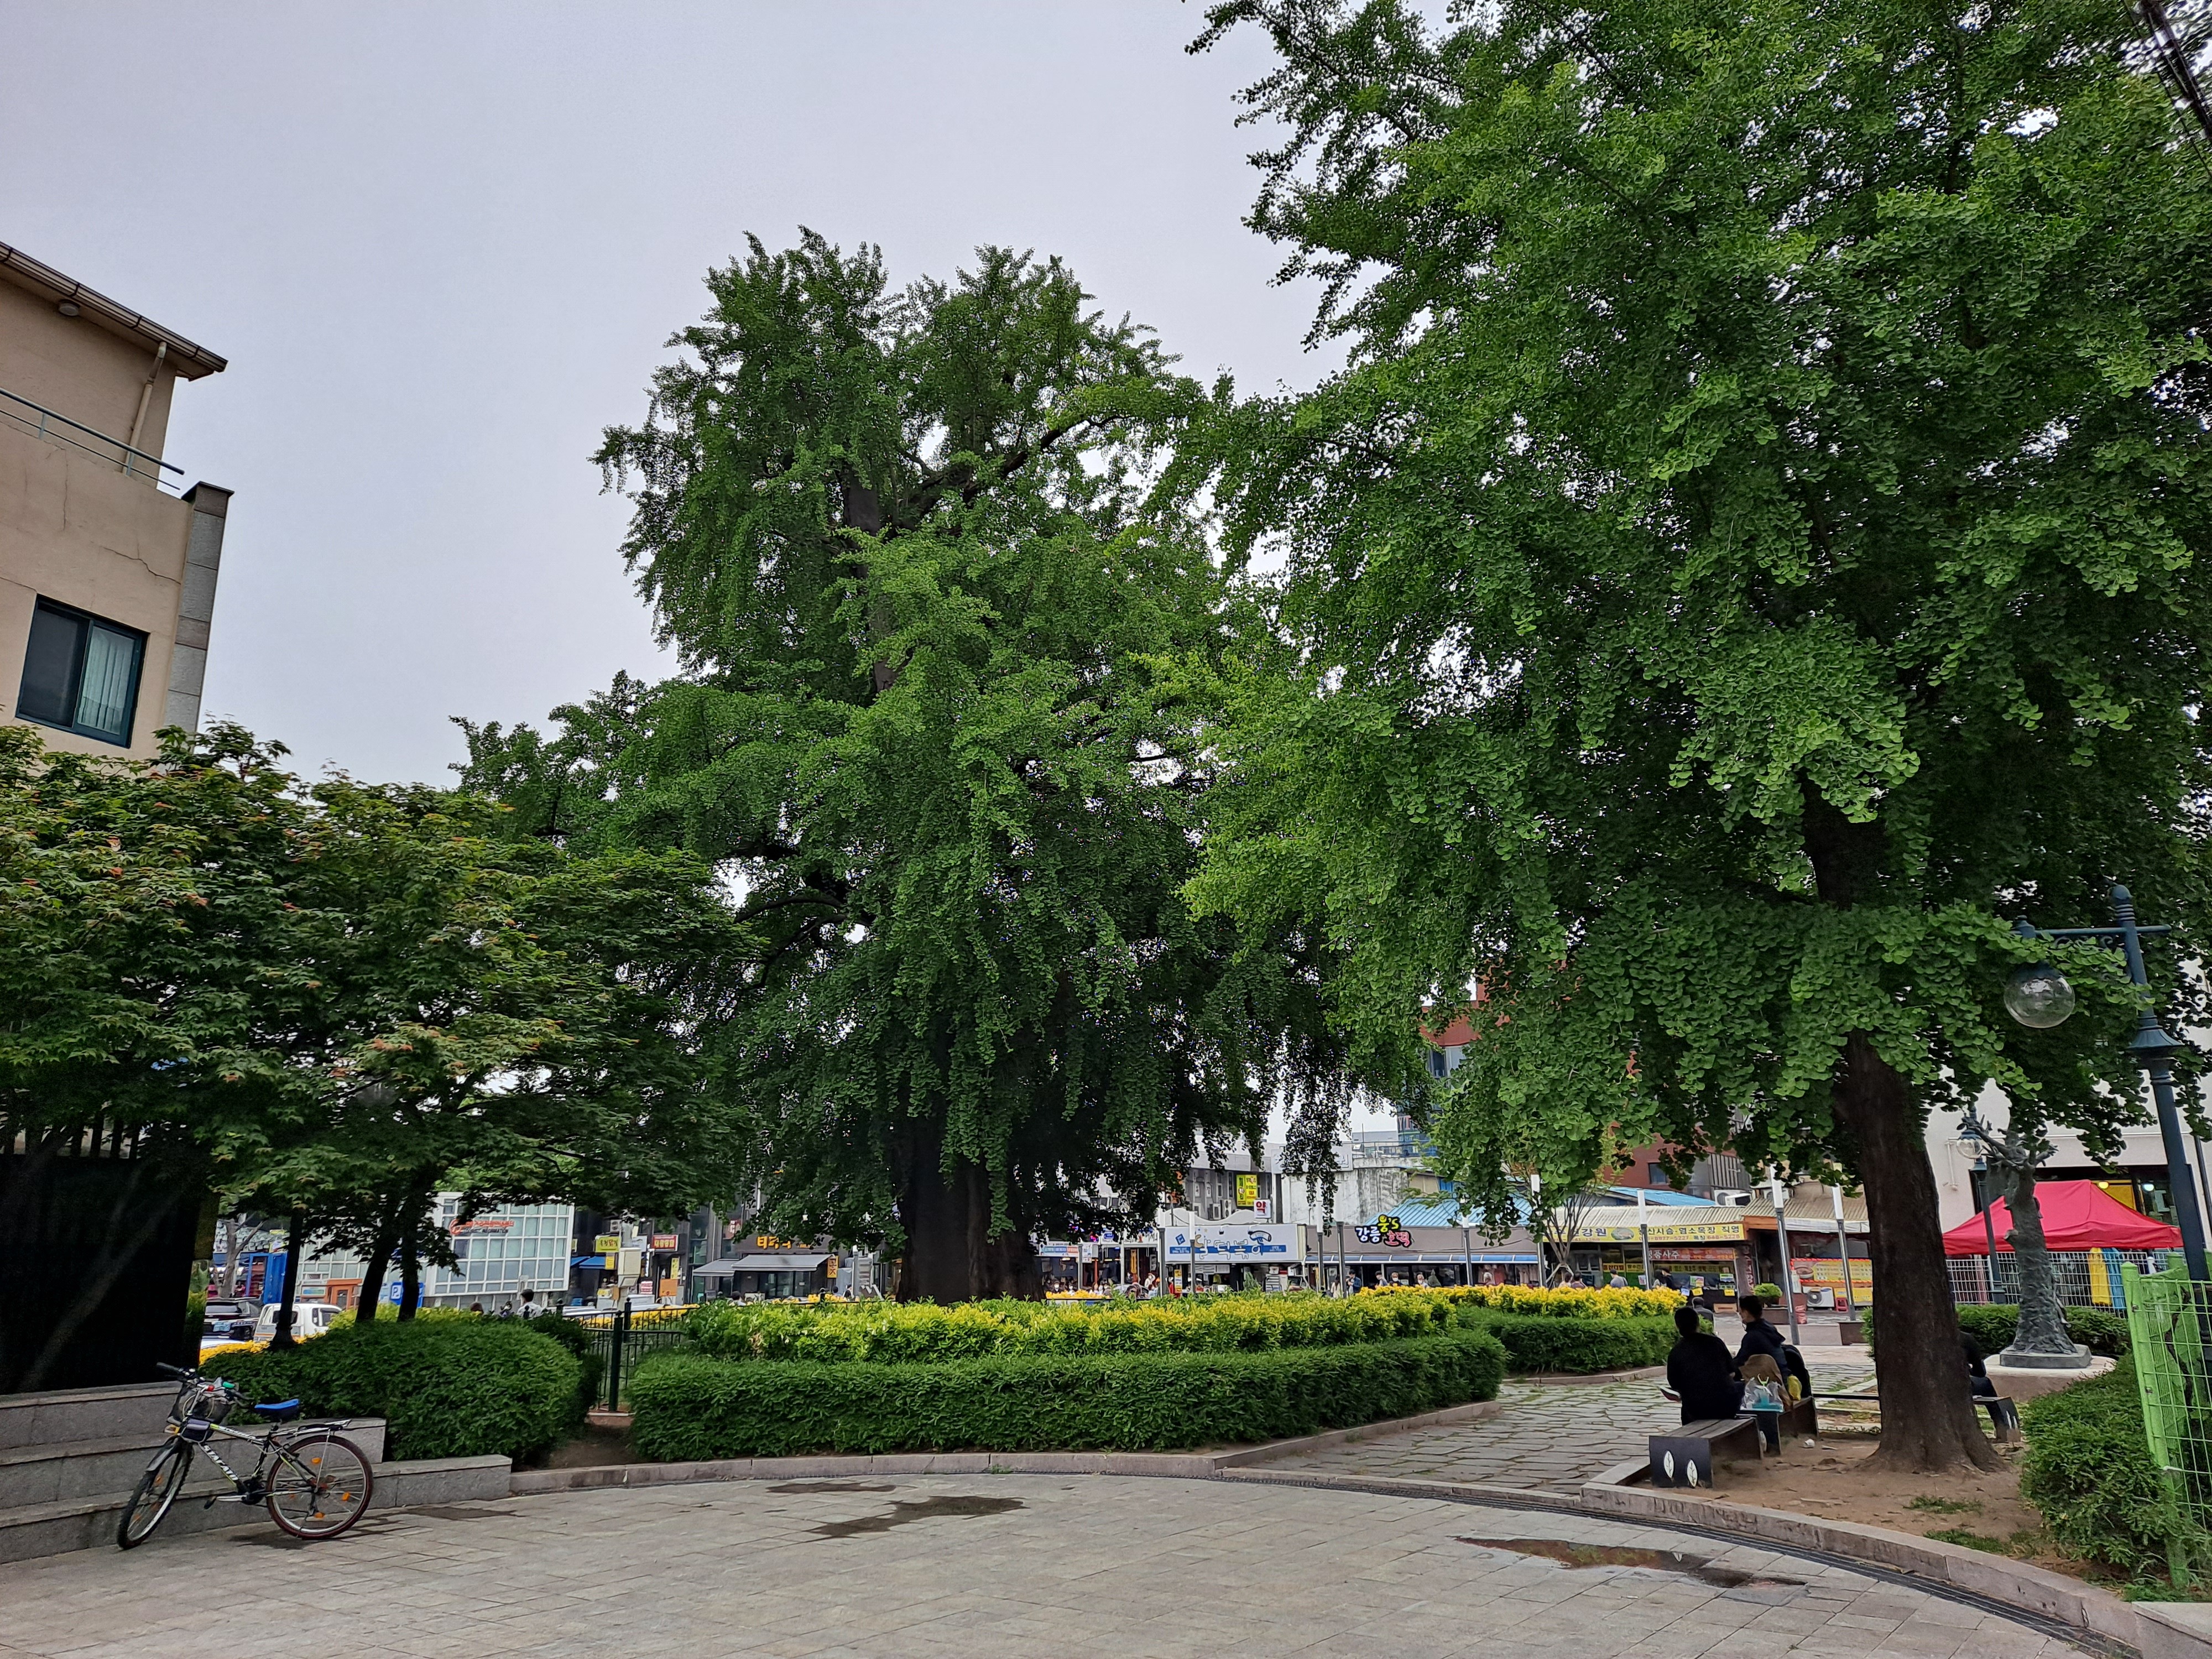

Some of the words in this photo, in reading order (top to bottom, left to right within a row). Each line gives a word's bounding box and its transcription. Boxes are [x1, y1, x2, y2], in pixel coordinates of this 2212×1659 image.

[1256, 1201, 1266, 1214] 약
[1355, 1226, 1381, 1243] 강릉
[1385, 1230, 1410, 1247] 호떡
